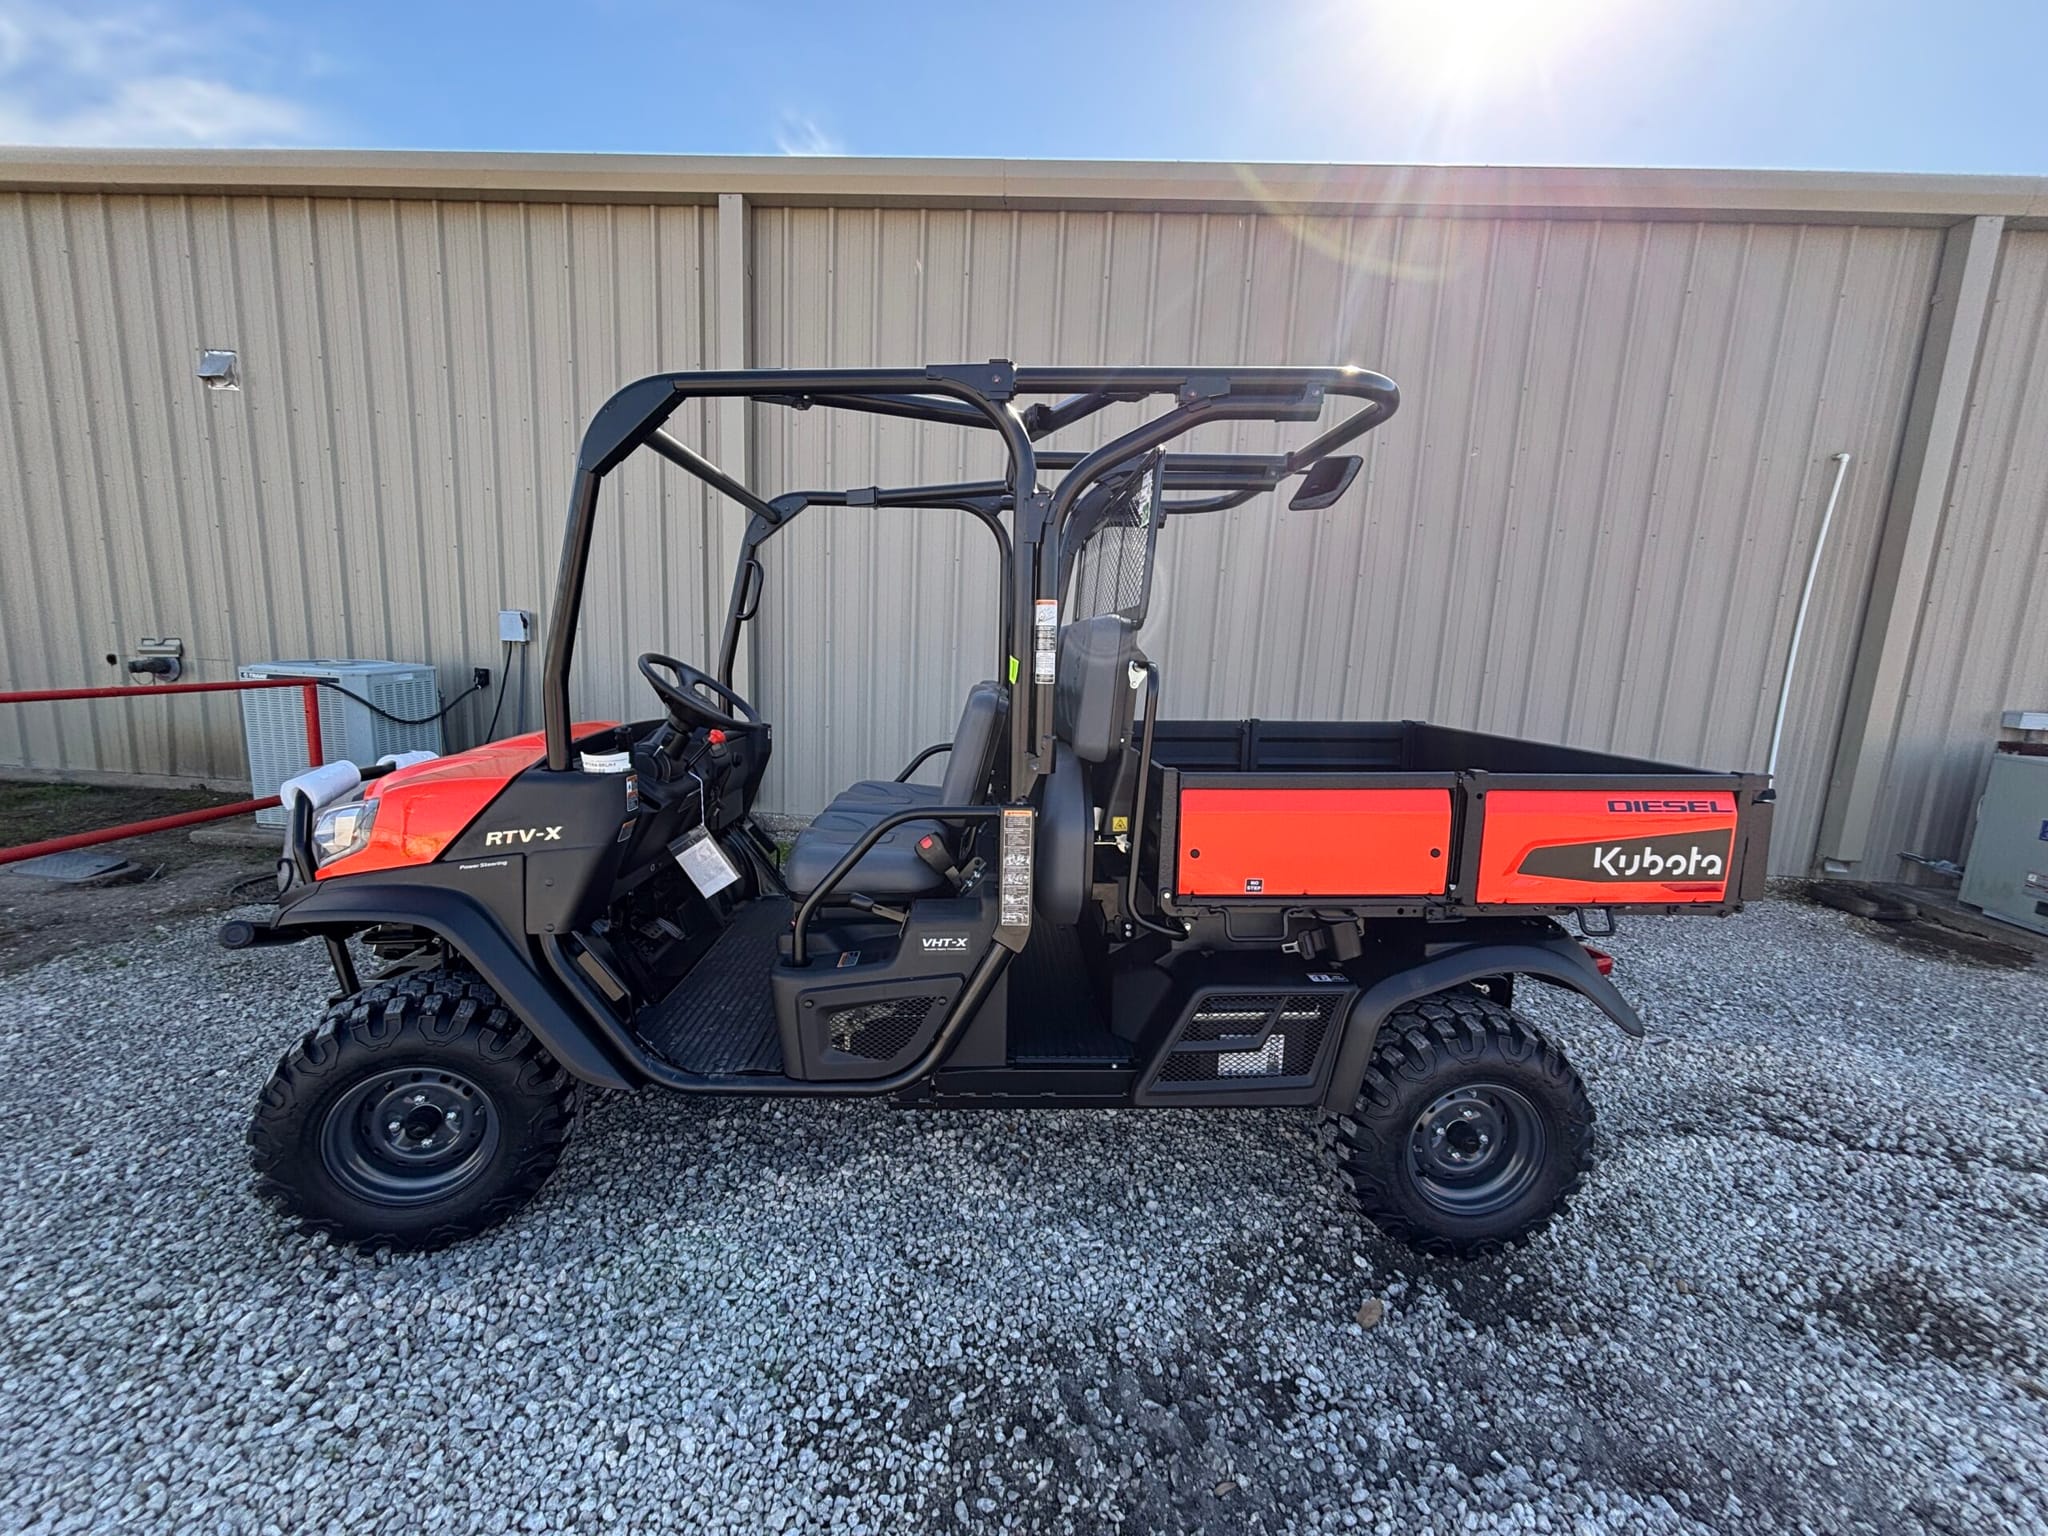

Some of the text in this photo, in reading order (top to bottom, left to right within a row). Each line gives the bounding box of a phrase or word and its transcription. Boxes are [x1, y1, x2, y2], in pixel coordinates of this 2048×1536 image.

[1607, 800, 1734, 813] DIESEL
[485, 825, 563, 846] RTV-X
[480, 860, 508, 868] Steering
[1593, 846, 1722, 876] Kubota
[922, 937, 968, 947] VHT-X
